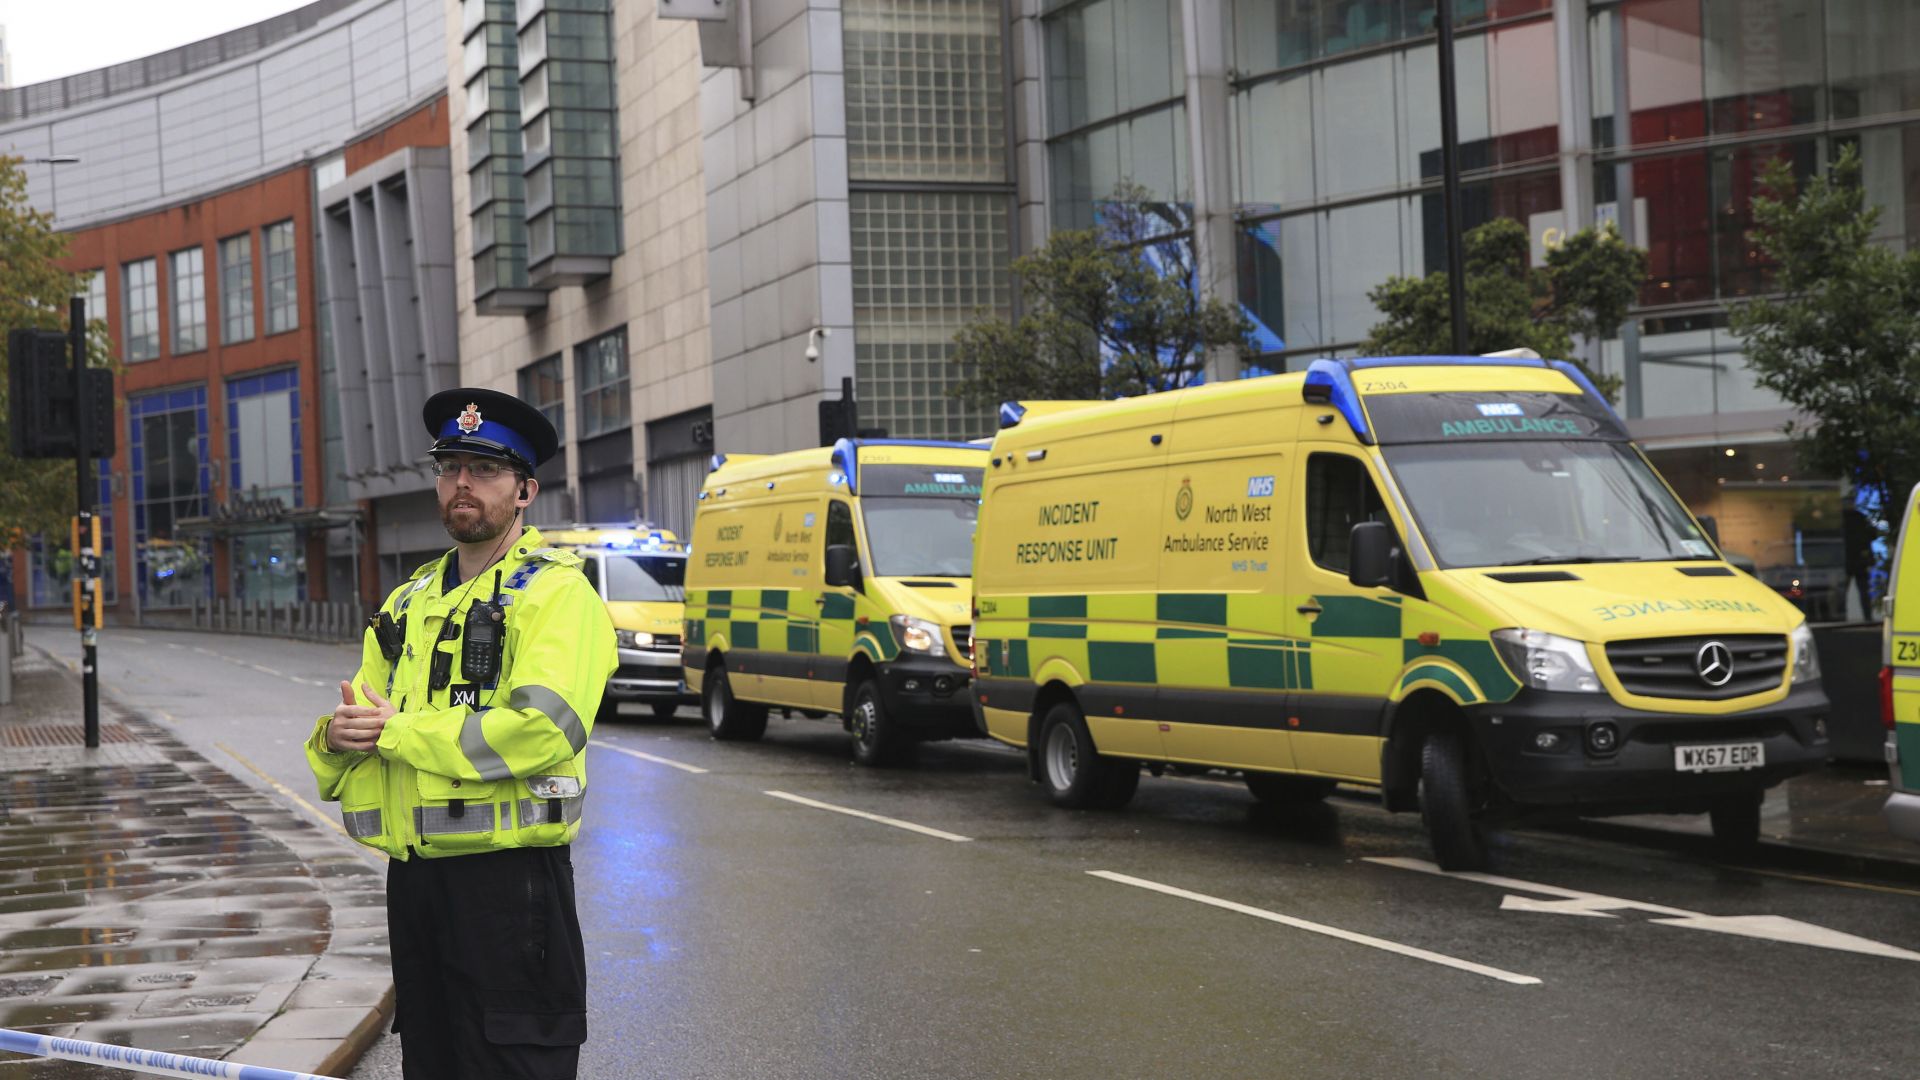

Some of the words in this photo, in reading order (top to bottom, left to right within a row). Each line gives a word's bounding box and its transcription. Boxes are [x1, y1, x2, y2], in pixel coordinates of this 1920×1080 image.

[1362, 381, 1408, 392] Z304
[1477, 403, 1523, 416] NHS
[1441, 417, 1583, 437] AMBULANCE
[1248, 476, 1275, 497] NHS
[1038, 501, 1099, 526] INCIDENT
[1205, 504, 1238, 523] North
[1242, 503, 1272, 522] West
[1016, 540, 1083, 564] RESPONSE
[1086, 538, 1118, 561] UNIT
[1163, 533, 1225, 552] Ambulance
[1228, 531, 1269, 551] Service
[1232, 560, 1248, 571] NHS
[1250, 560, 1268, 571] Trust
[1897, 641, 1920, 661] Z3
[454, 690, 475, 705] XM
[1683, 747, 1726, 766] WX67
[1731, 745, 1759, 764] EDR
